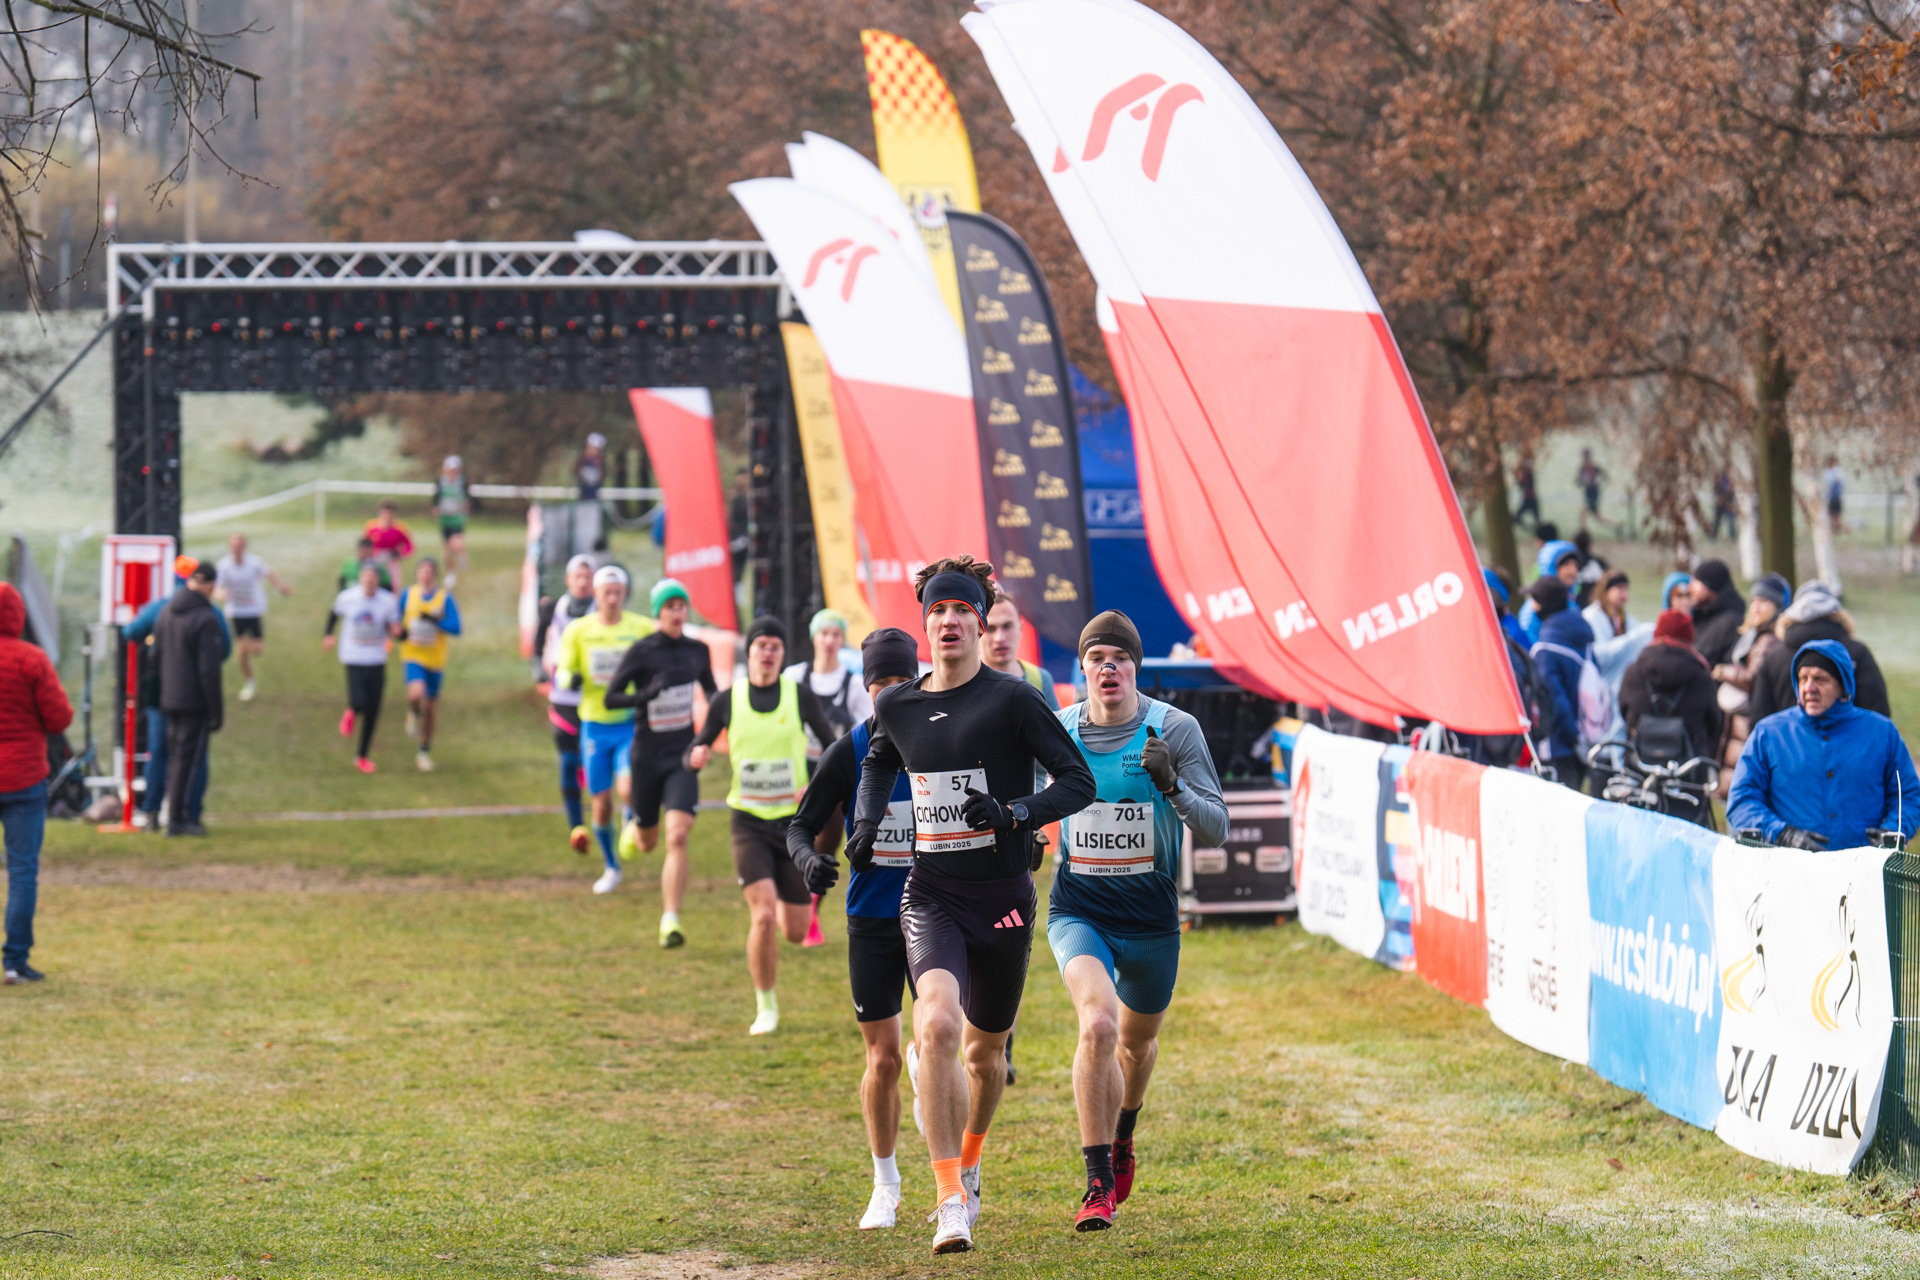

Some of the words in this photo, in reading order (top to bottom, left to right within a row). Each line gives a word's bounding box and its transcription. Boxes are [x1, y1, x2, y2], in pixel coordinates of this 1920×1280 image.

[952, 775, 971, 791] 57
[1114, 806, 1146, 821] 701
[930, 843, 951, 851] LUBIN
[952, 840, 972, 849] 2025
[1076, 831, 1145, 849] LISIECKI
[1790, 1062, 1862, 1139] DZLA
